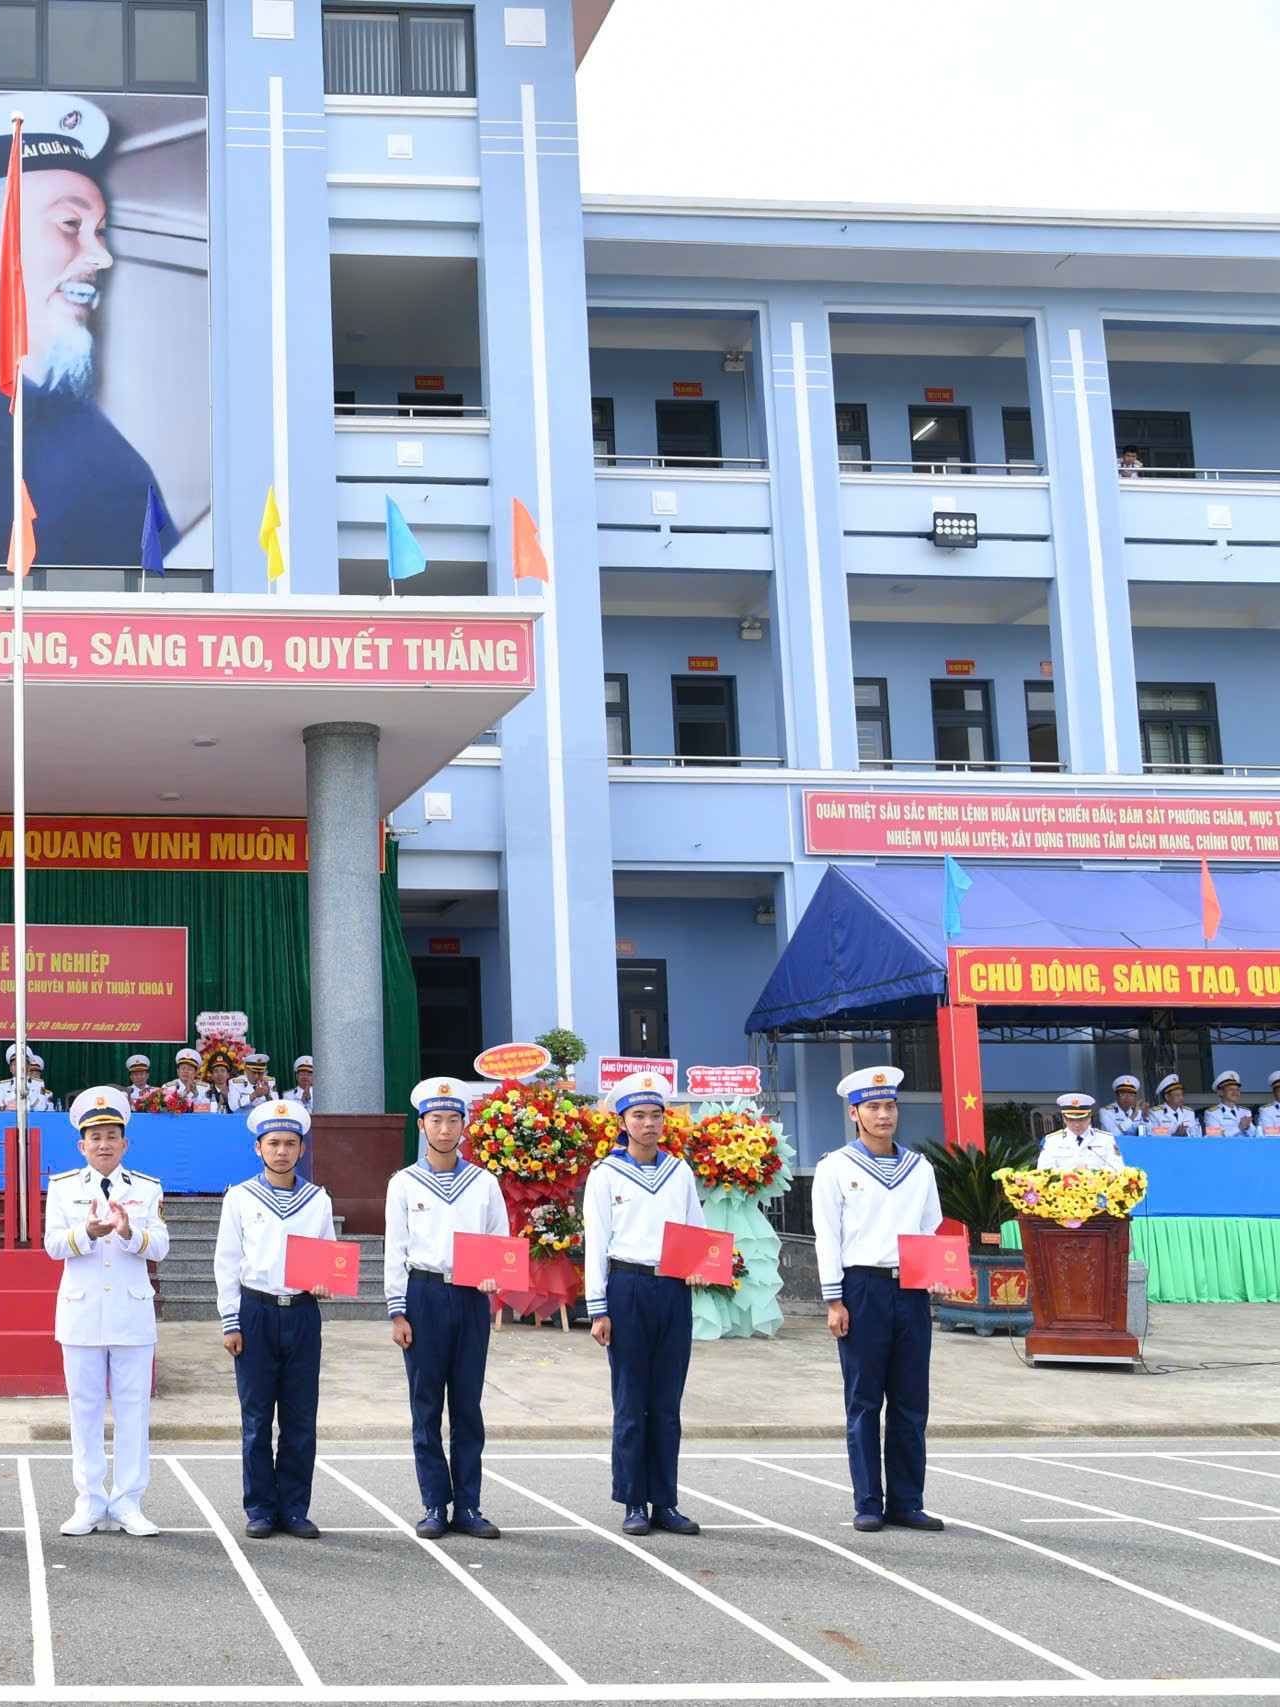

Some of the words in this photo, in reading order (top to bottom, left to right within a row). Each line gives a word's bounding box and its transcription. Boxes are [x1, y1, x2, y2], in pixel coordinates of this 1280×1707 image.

[90, 627, 186, 668] SÁNG
[198, 634, 273, 674] TẠO,
[285, 627, 392, 672] QUYẾT
[403, 627, 518, 672] THẮNG
[816, 801, 846, 819] QUÁN
[848, 801, 877, 822] TRIỆT
[879, 801, 902, 821] SÂU
[903, 800, 925, 821] SẮC
[927, 803, 959, 825] MỆNH
[961, 804, 989, 825] LỆNH
[991, 801, 1021, 823] HUẤN
[1022, 804, 1056, 827] LUYỆN
[1058, 803, 1090, 824] CHIẾN
[1091, 803, 1117, 825] ĐẤU;
[1119, 806, 1144, 824] BÁM
[1146, 806, 1166, 824] SÁT
[1168, 807, 1211, 826] PHƯƠNG
[1213, 807, 1247, 827] CHÂM,
[1249, 810, 1273, 829] MỤC
[24, 831, 121, 862] QUANG
[131, 832, 201, 861] VINH
[210, 826, 295, 862] MUÔN
[886, 828, 922, 848] NHIỆM
[924, 830, 938, 850] VỤ
[940, 826, 970, 848] HUẤN
[972, 829, 1009, 850] LUYỆN;
[1011, 829, 1033, 848] XÂY
[1034, 831, 1064, 852] DỰNG
[1066, 832, 1101, 849] TRUNG
[1102, 832, 1126, 849] TÂM
[1128, 831, 1157, 850] CÁCH
[1159, 834, 1194, 853] MẠNG,
[1196, 832, 1229, 851] CHÍNH
[1230, 835, 1253, 852] QUY,
[1254, 836, 1279, 851] TINH
[24, 945, 46, 973] ỐT
[50, 950, 110, 977] NGHIỆP
[27, 978, 64, 993] CHUYÊN
[66, 979, 88, 994] MÔN
[106, 979, 136, 997] THUẬT
[166, 982, 174, 996] V
[970, 956, 1022, 993] CHỦ
[1030, 959, 1106, 998] ĐỘNG,
[1113, 960, 1180, 994] SÁNG
[1187, 965, 1241, 999] TẠO,
[50, 1020, 80, 1031] tháng
[92, 1021, 115, 1031] năm
[115, 1022, 142, 1032] 2025
